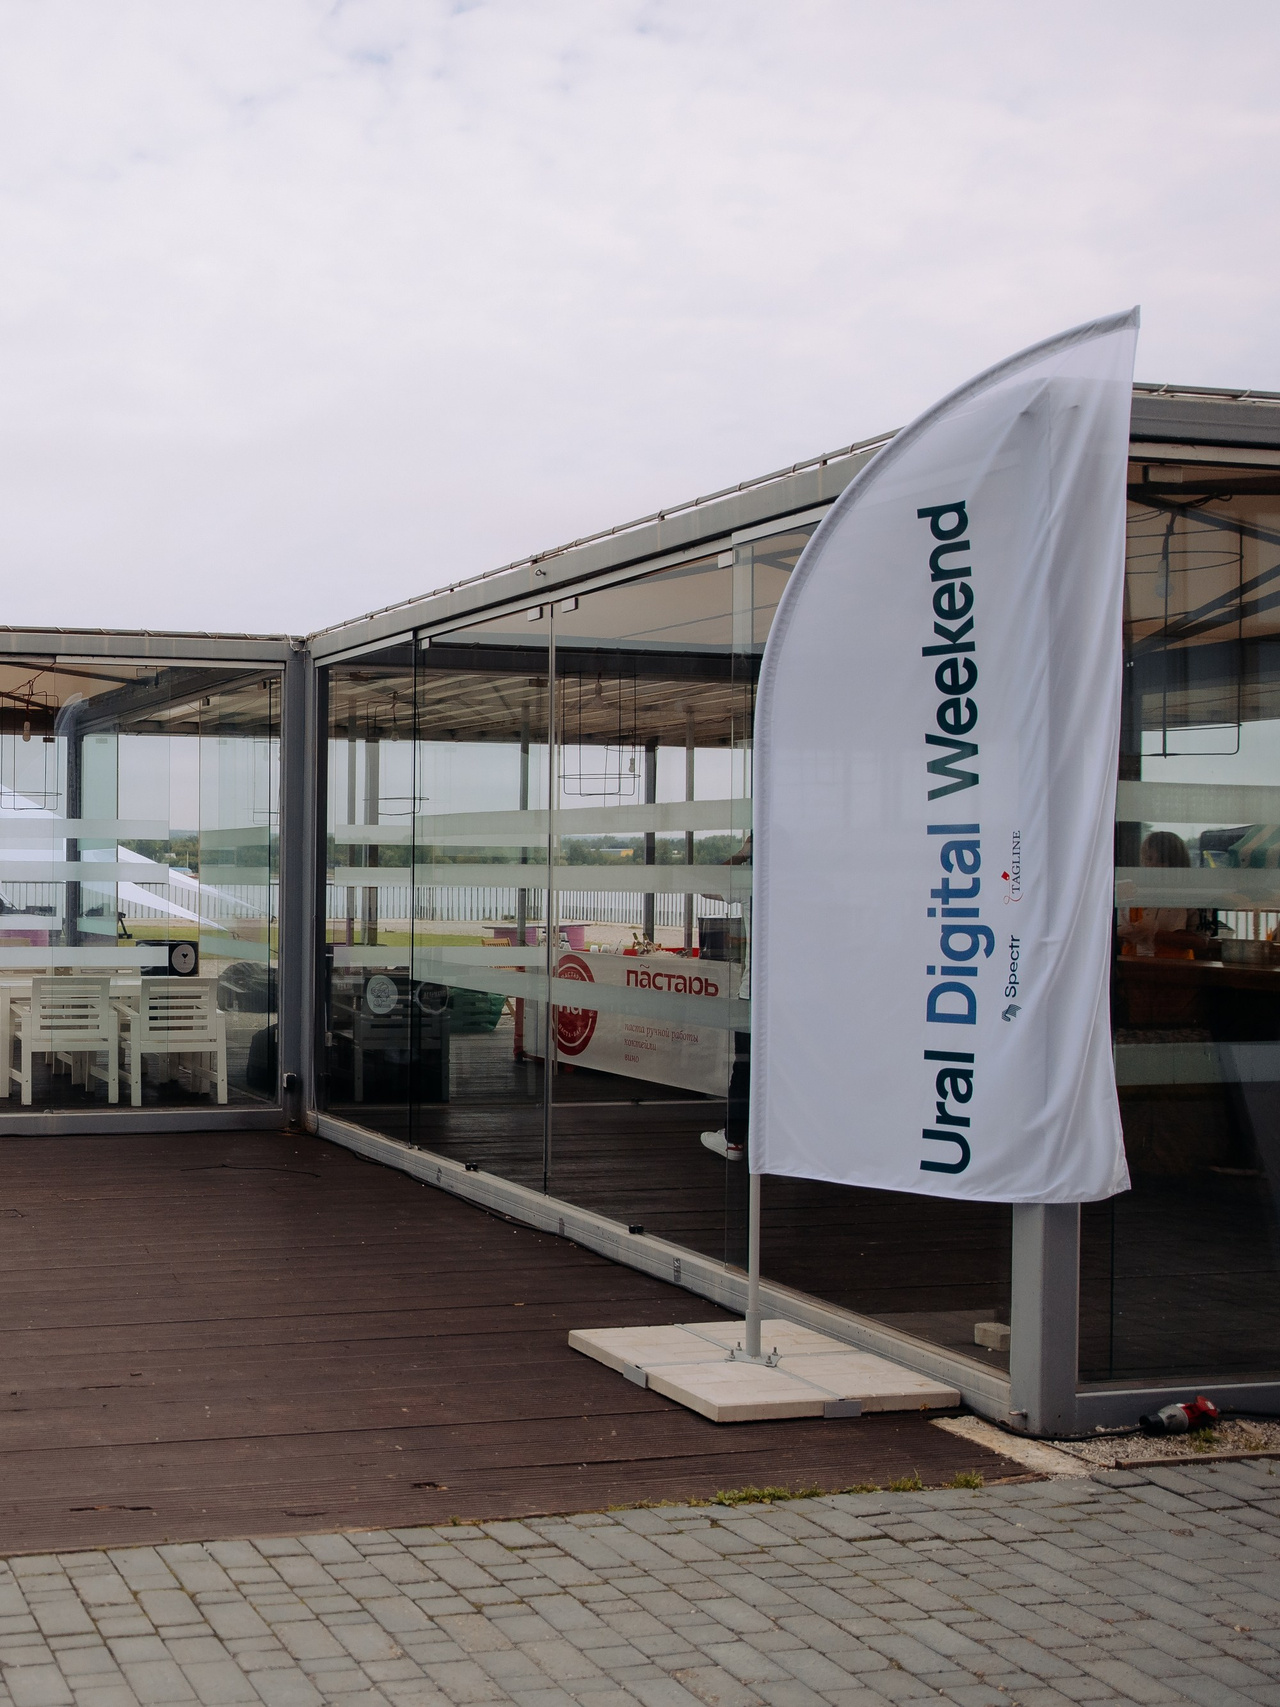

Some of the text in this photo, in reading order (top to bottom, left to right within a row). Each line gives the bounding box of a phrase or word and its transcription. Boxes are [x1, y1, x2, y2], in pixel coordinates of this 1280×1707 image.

[917, 499, 995, 1175] Ural Digital Weekend
[1012, 830, 1021, 894] TAGLINE
[1005, 935, 1020, 998] Spectr
[624, 1023, 699, 1043] паста ручной работы
[624, 1053, 640, 1063] вино
